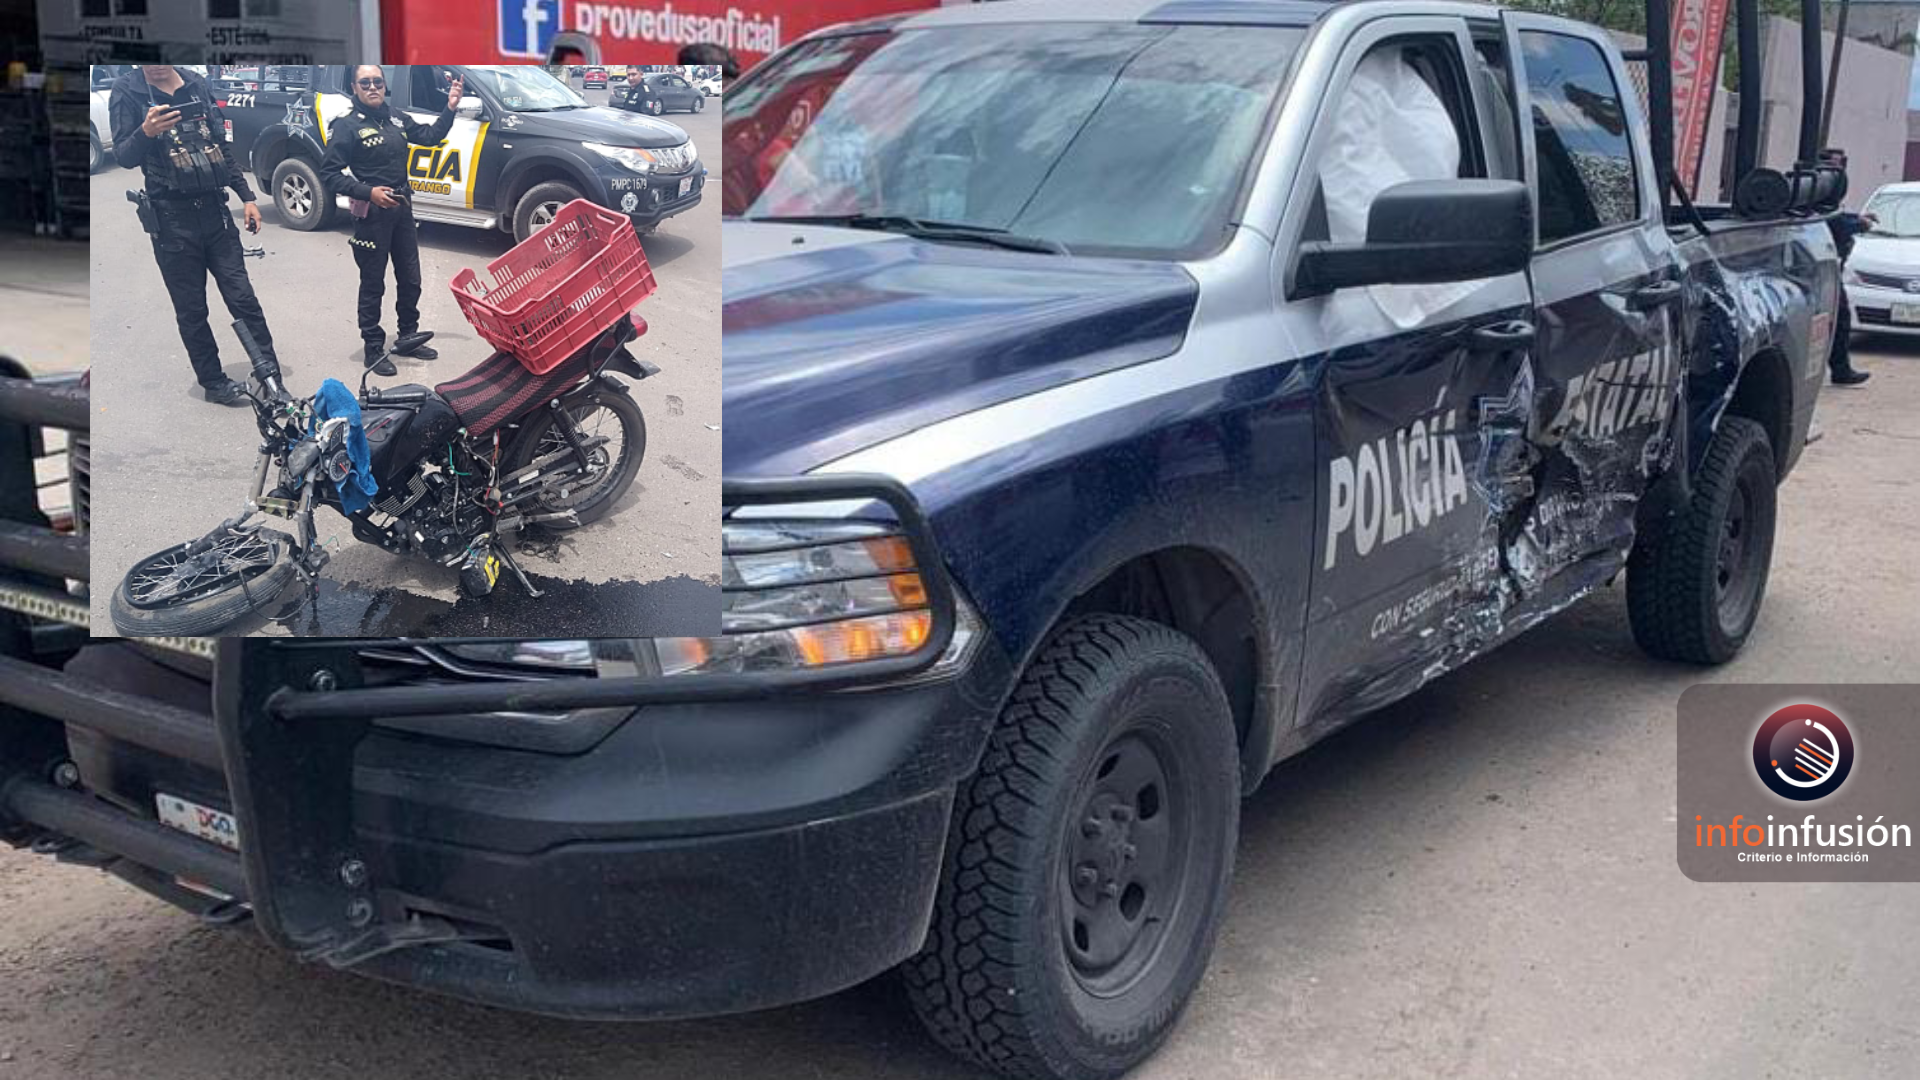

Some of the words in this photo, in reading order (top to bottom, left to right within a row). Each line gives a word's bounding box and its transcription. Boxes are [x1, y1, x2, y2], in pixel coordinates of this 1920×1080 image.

[575, 2, 780, 52] provedusaoficial
[227, 92, 256, 108] 2271
[407, 138, 462, 183] CÍA
[611, 177, 632, 191] PMPC
[632, 178, 648, 191] 1679
[1551, 346, 1677, 440] ESTATAL
[1324, 385, 1468, 571] POLICÍA
